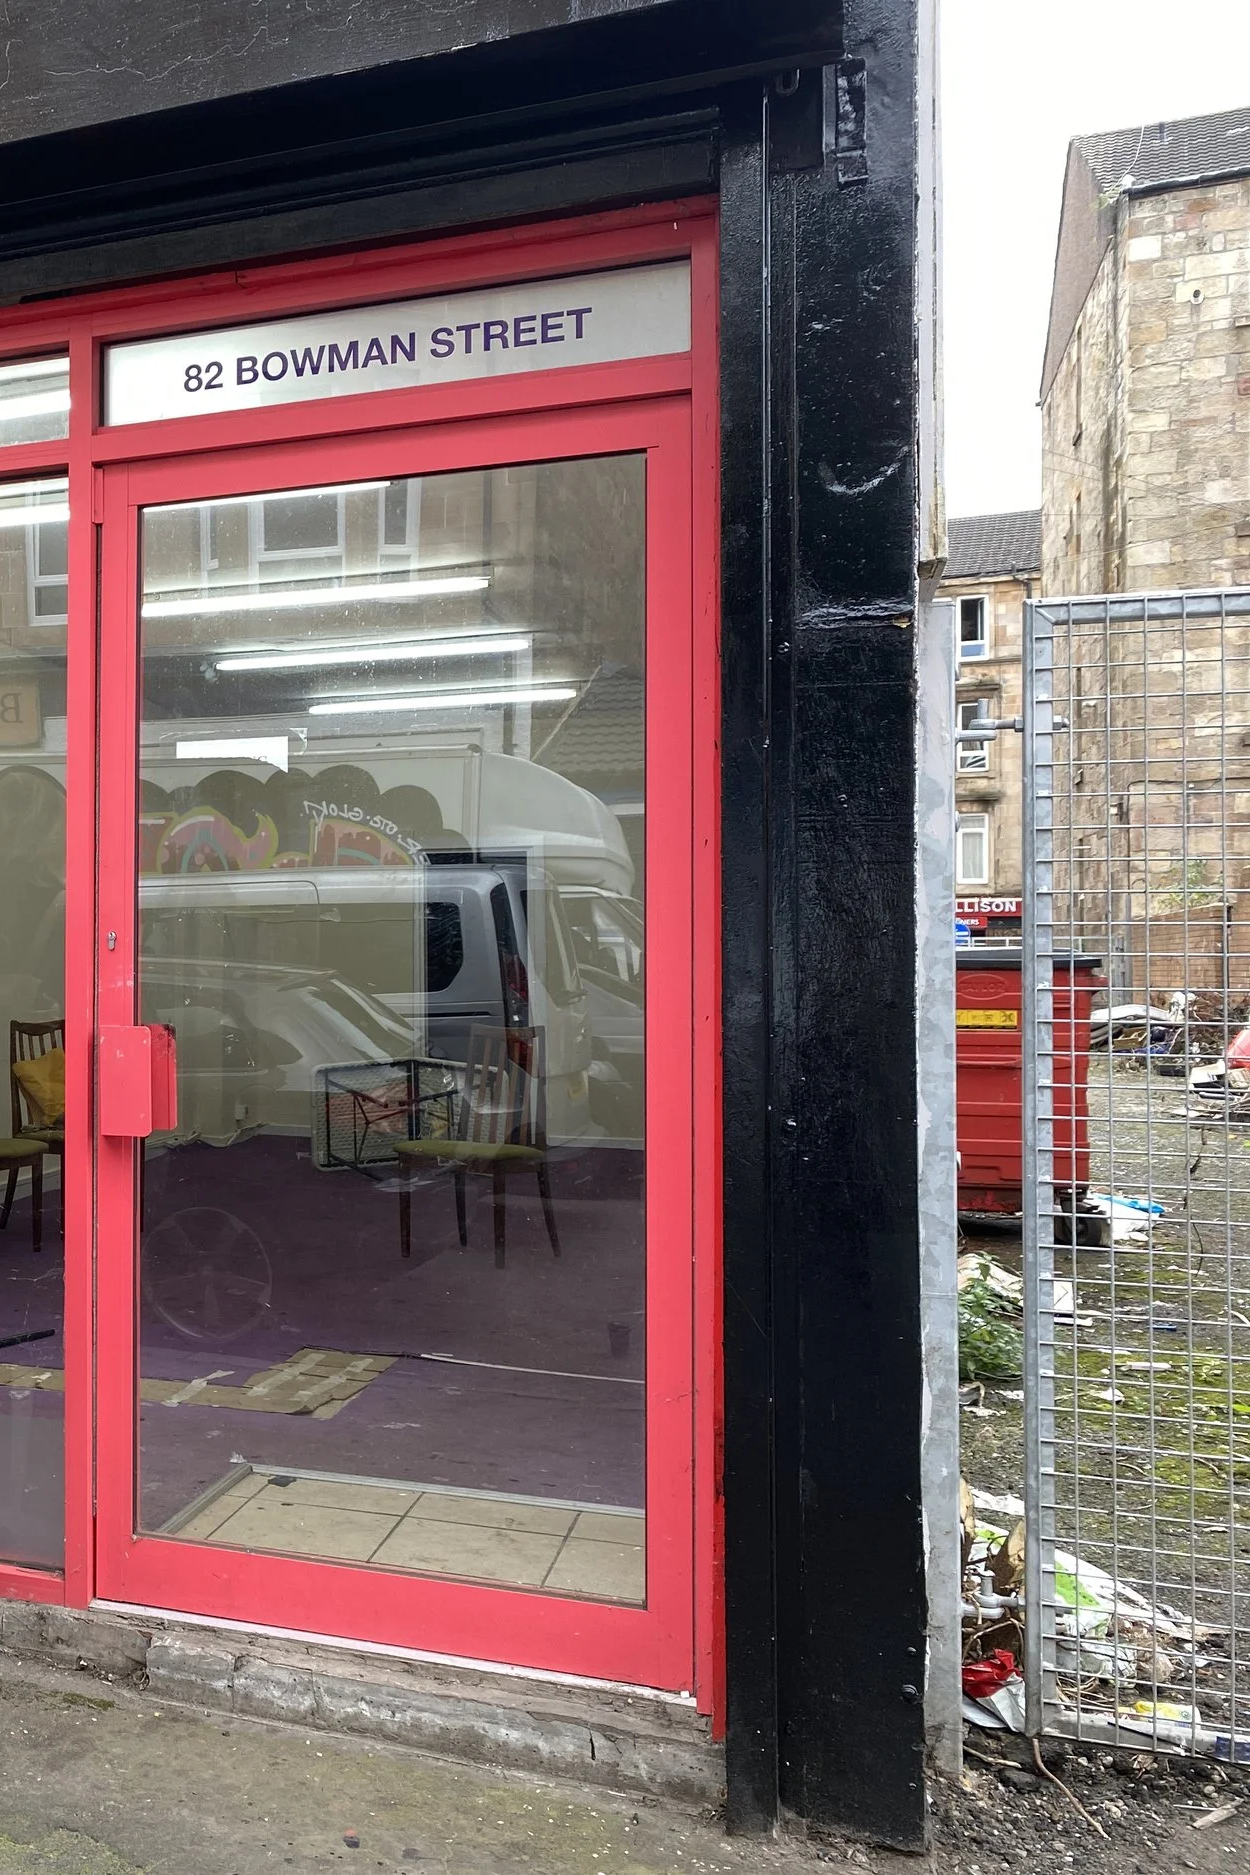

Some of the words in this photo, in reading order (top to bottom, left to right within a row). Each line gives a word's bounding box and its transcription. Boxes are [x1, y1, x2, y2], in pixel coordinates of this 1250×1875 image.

[183, 361, 224, 392] 82
[236, 332, 417, 386] BOWMAN
[430, 307, 593, 359] STREET
